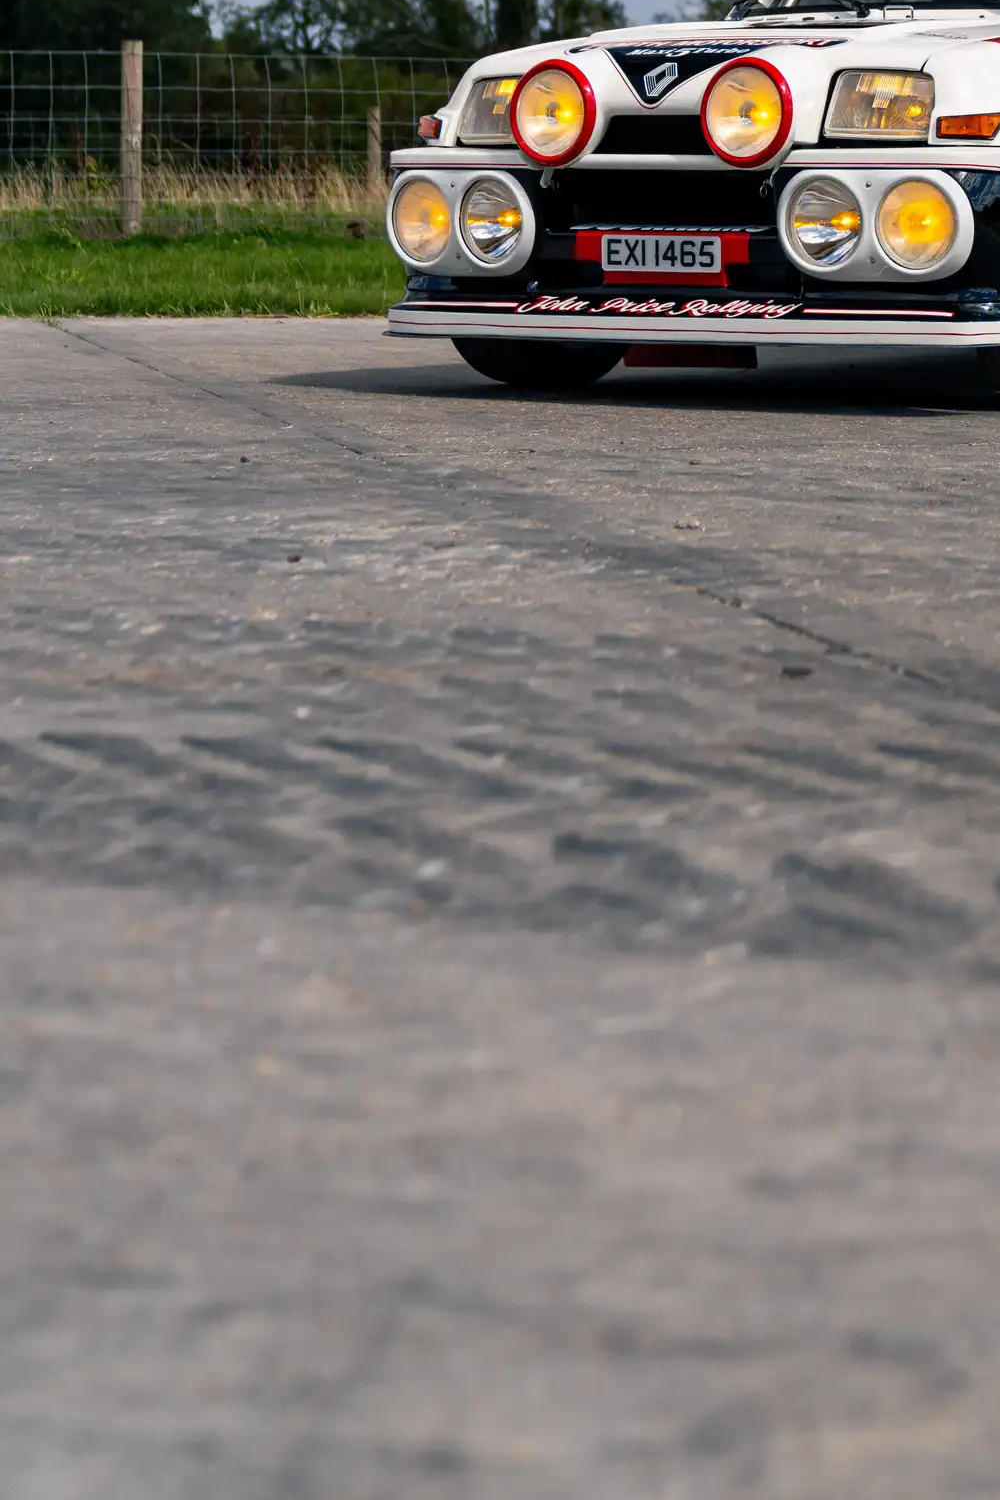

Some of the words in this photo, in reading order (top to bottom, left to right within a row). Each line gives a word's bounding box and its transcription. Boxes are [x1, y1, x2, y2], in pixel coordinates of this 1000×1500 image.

[515, 296, 590, 313] John
[591, 297, 676, 314] Price
[669, 299, 803, 319] Rallying
